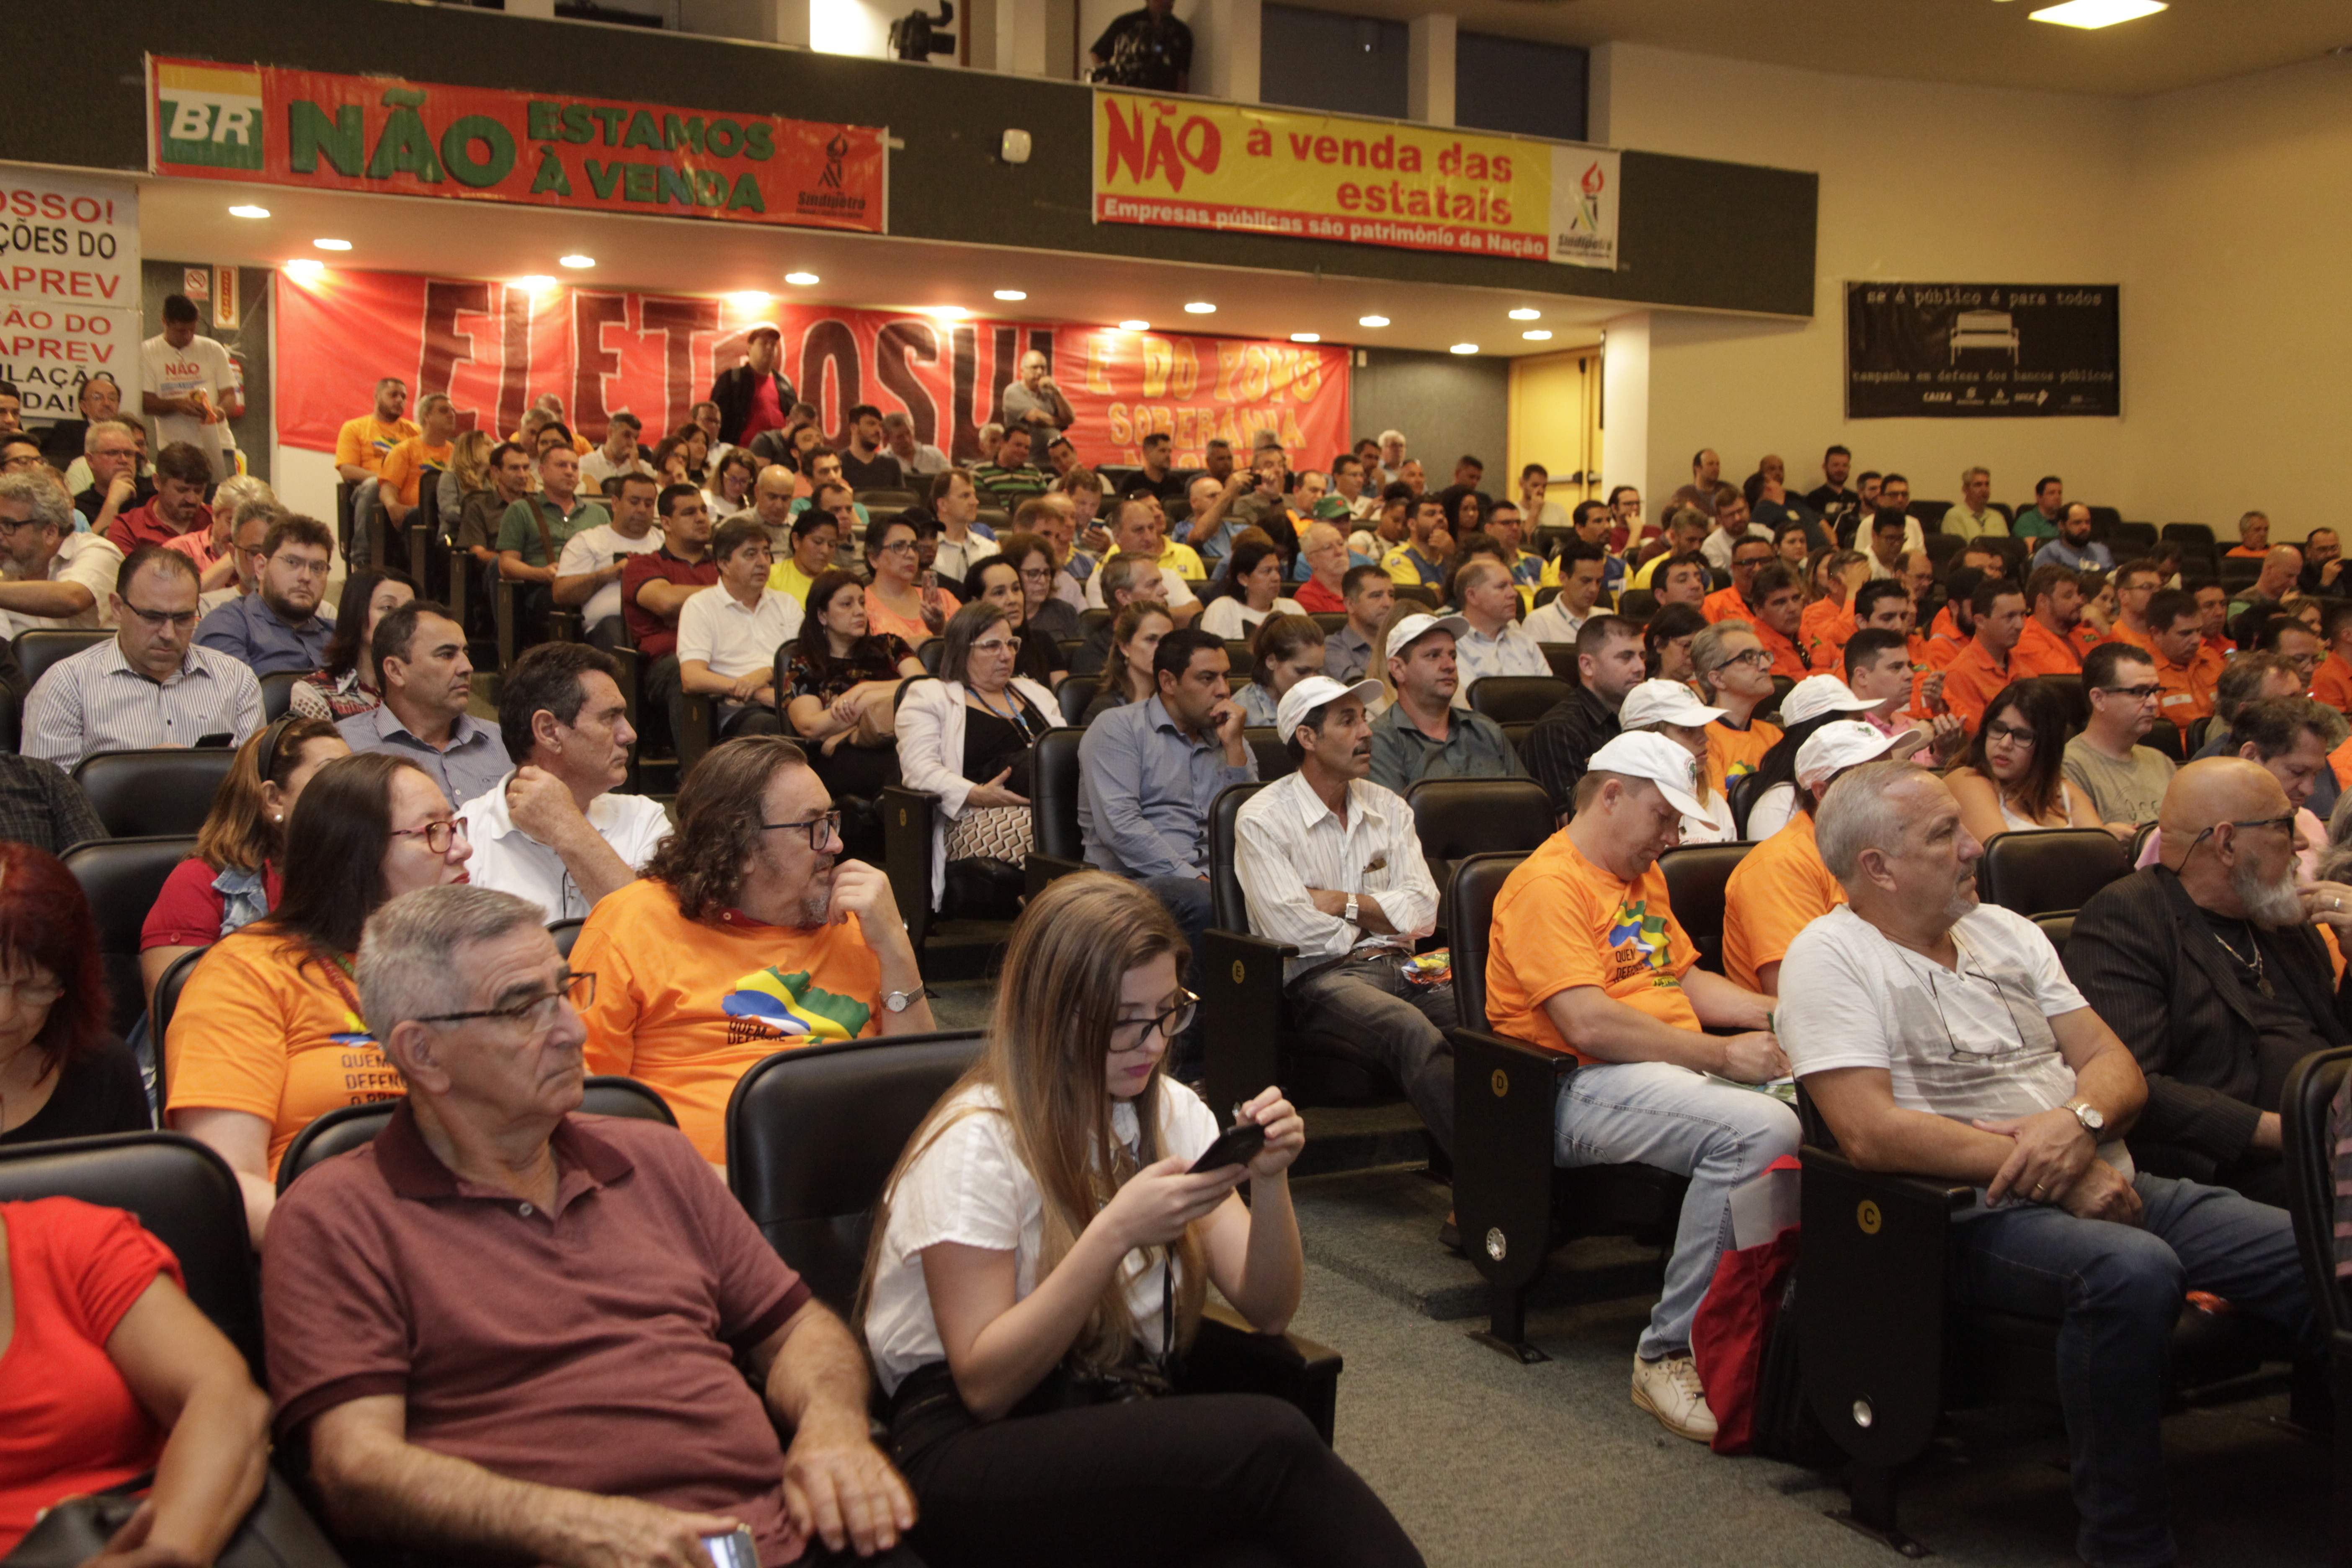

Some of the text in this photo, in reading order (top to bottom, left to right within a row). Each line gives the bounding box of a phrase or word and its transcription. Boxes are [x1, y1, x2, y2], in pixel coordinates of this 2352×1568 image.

[169, 102, 253, 146] BR
[288, 87, 776, 188] NÃO ESTAMOS
[1104, 98, 1221, 193] NÃO
[1288, 132, 1422, 173] venda
[1438, 142, 1512, 183] das
[530, 145, 766, 213] À VENDA
[0, 190, 113, 225] SSO!
[1336, 179, 1512, 226] estatais
[1104, 197, 1545, 257] Empresas públicas são patrimônio da Nação
[78, 230, 116, 260] DO
[1914, 288, 1982, 308] público
[2010, 292, 2047, 308] para
[2056, 290, 2102, 306] todos
[0, 304, 112, 335] ÃO DO
[0, 363, 115, 390] LAÇÃ
[1142, 336, 1200, 401] DO
[1213, 340, 1323, 403] POVO
[1923, 391, 1953, 402] CAIXA
[1235, 965, 1241, 978] E
[1496, 1075, 1504, 1089] D
[1864, 1208, 1875, 1225] C
